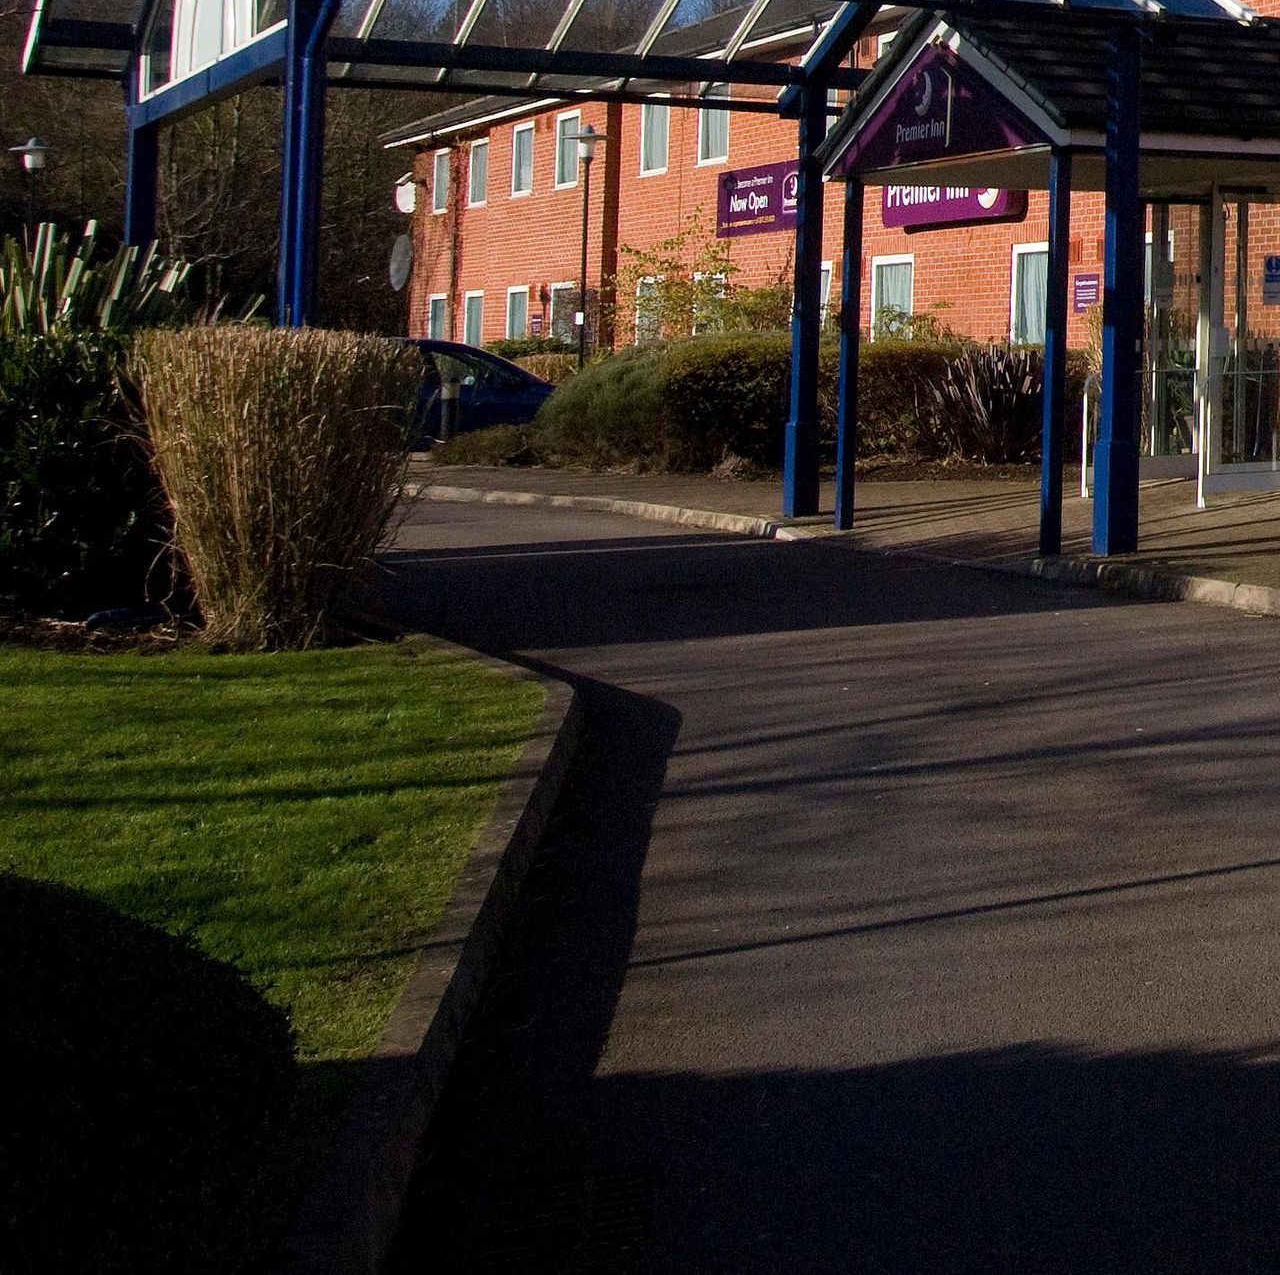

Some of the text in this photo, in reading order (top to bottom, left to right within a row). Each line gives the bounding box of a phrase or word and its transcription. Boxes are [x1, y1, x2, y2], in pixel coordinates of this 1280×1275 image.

[896, 118, 945, 144] Premier Inn
[729, 191, 768, 215] Now Open
